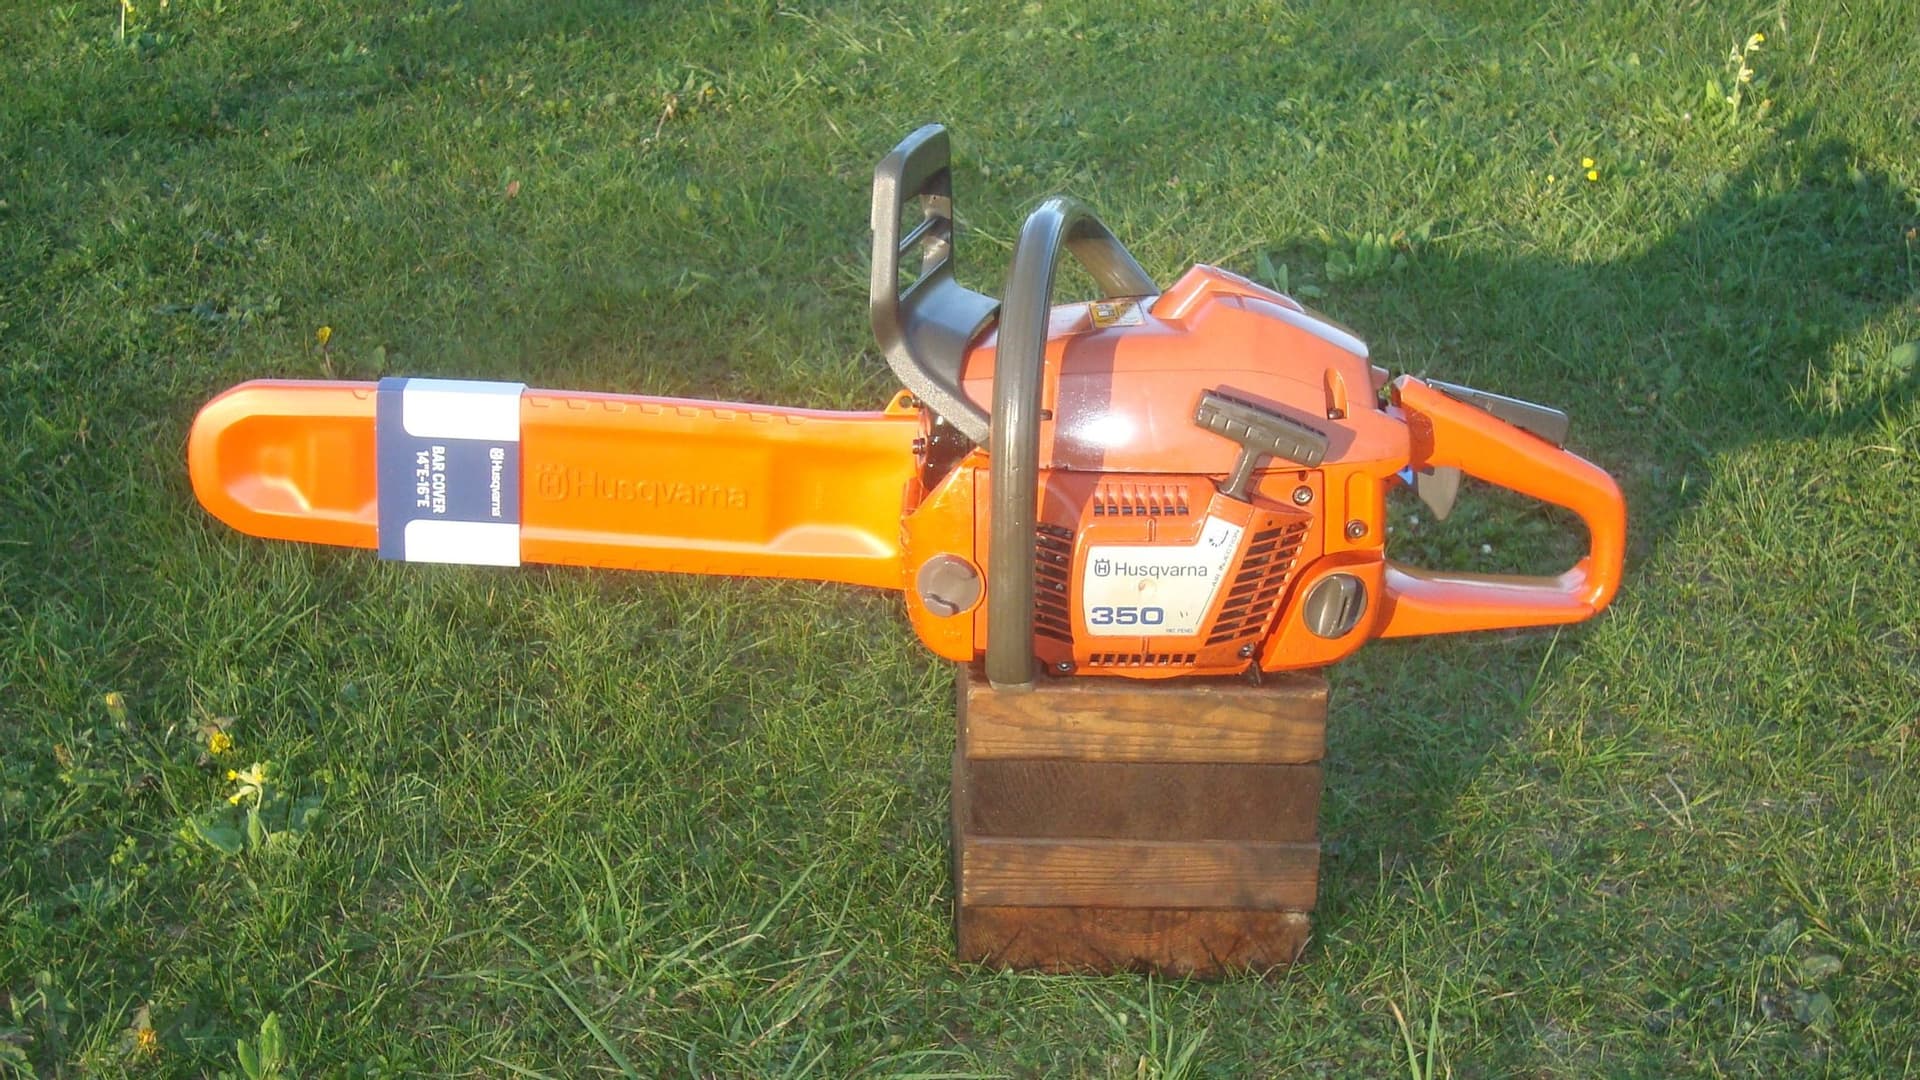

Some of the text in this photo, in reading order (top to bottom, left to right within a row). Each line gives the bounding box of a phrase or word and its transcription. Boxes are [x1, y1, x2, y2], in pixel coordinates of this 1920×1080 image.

[432, 445, 446, 514] BAR COVER
[490, 460, 503, 517] Husqvarna
[575, 469, 750, 510] Husqvarna
[1114, 562, 1209, 580] Husqvarna
[1090, 606, 1164, 625] 350
